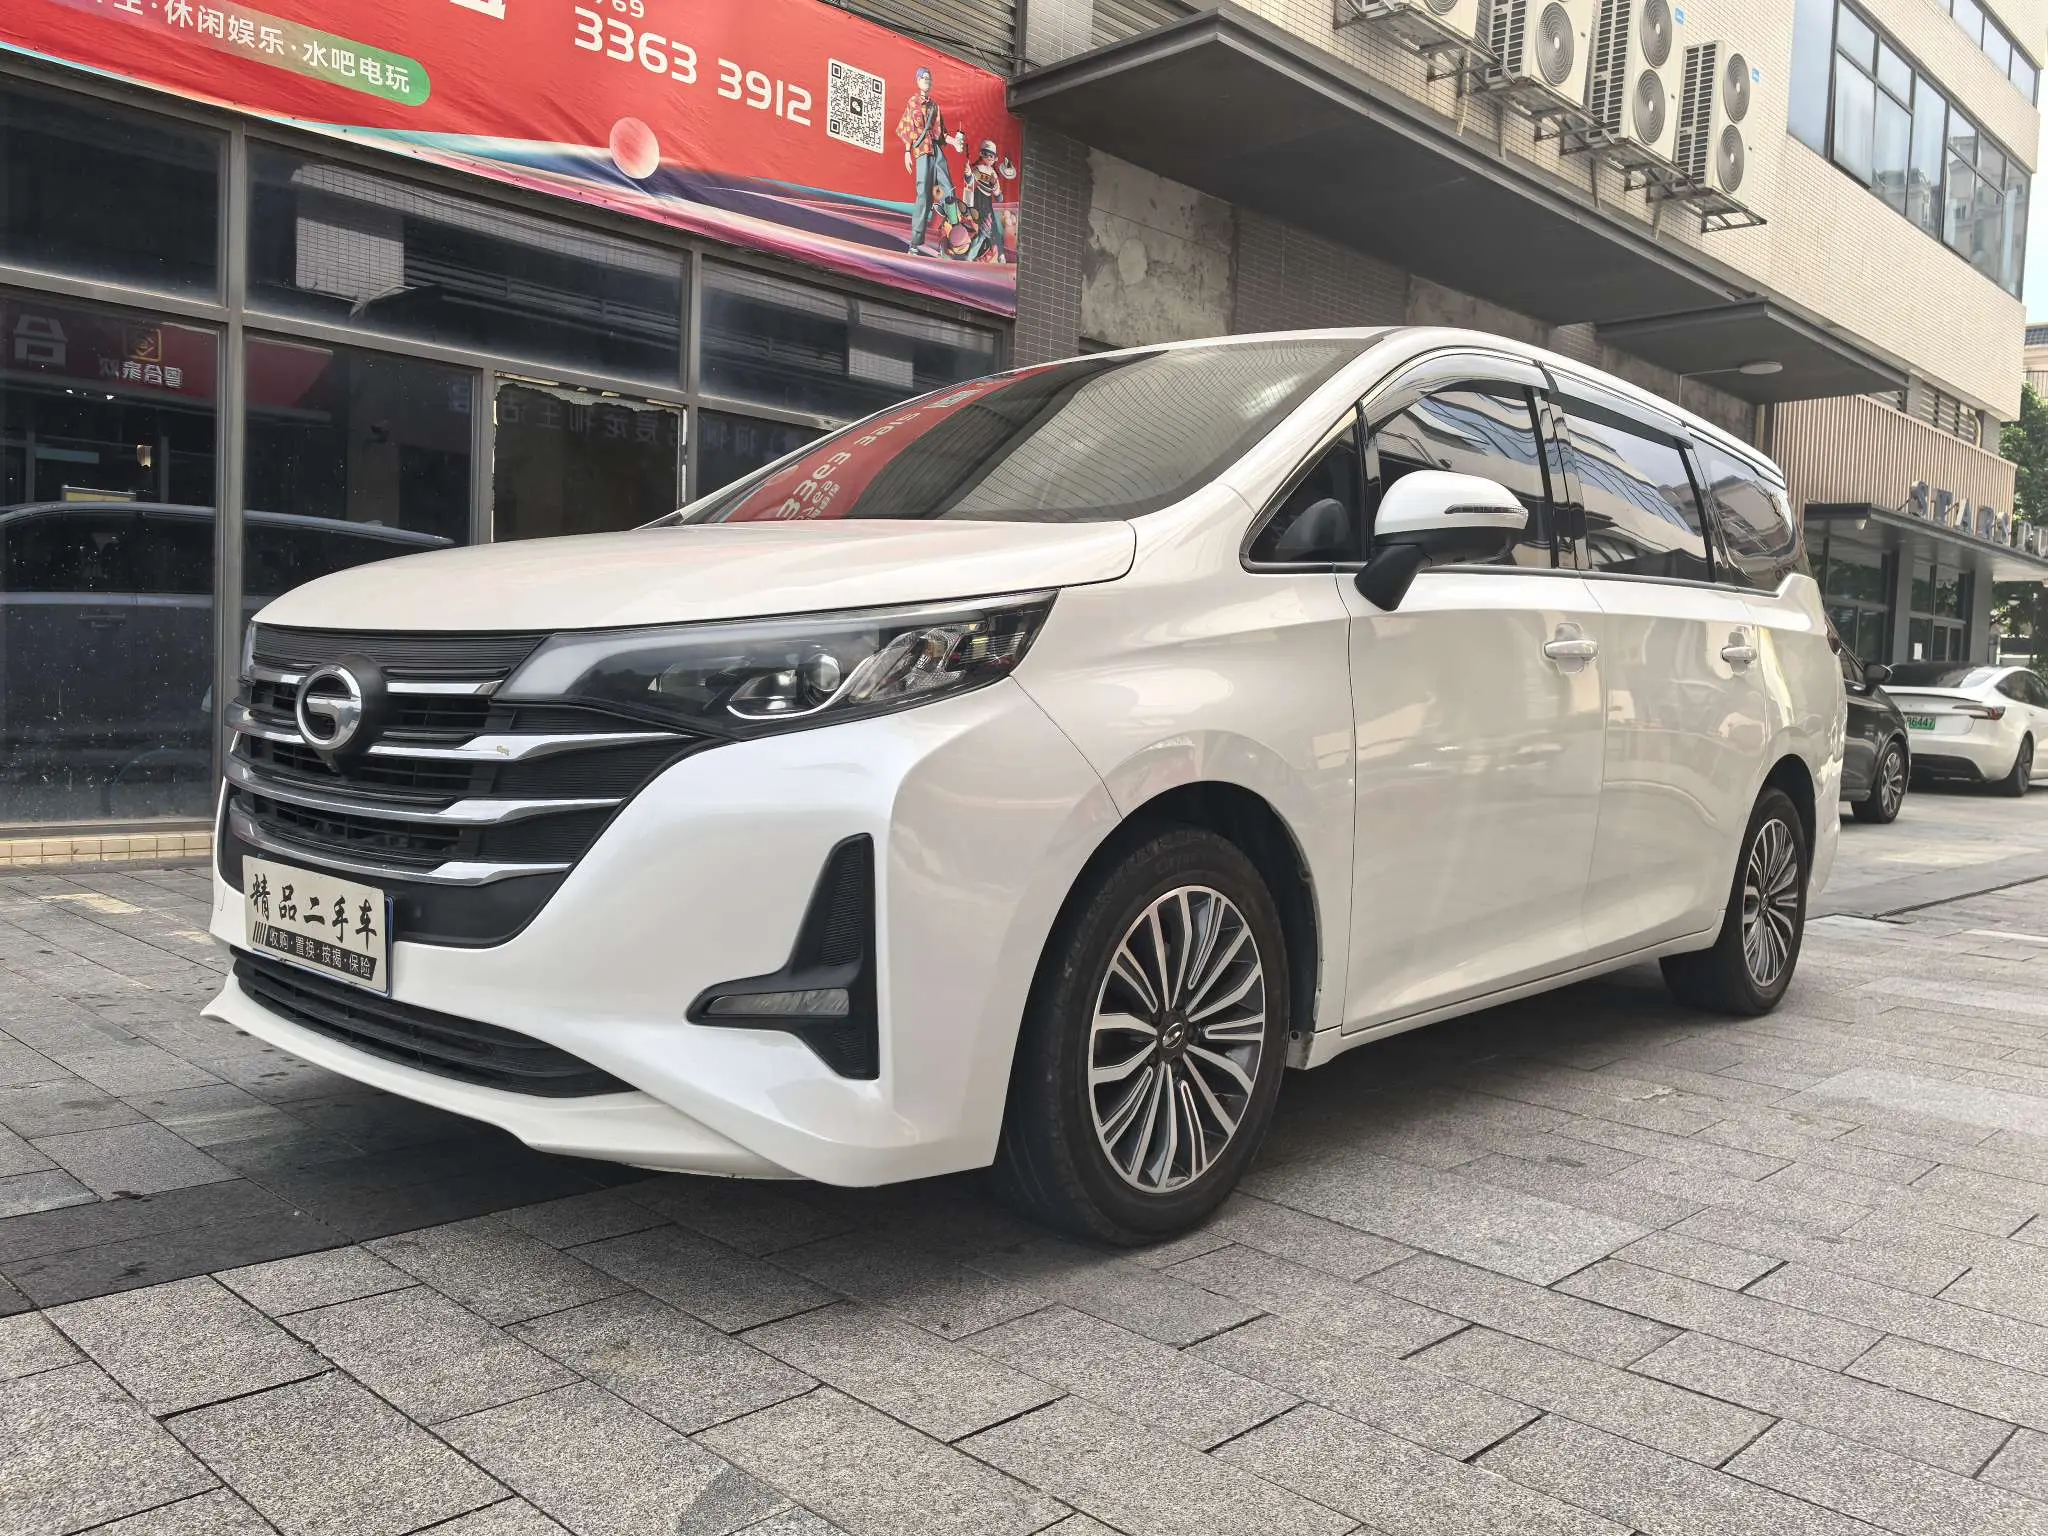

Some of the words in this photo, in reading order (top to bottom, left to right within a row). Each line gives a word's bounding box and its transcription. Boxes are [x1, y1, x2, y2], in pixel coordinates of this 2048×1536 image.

[574, 6, 697, 84] 3363
[717, 57, 812, 126] 3912
[249, 873, 377, 951] 精品二手车
